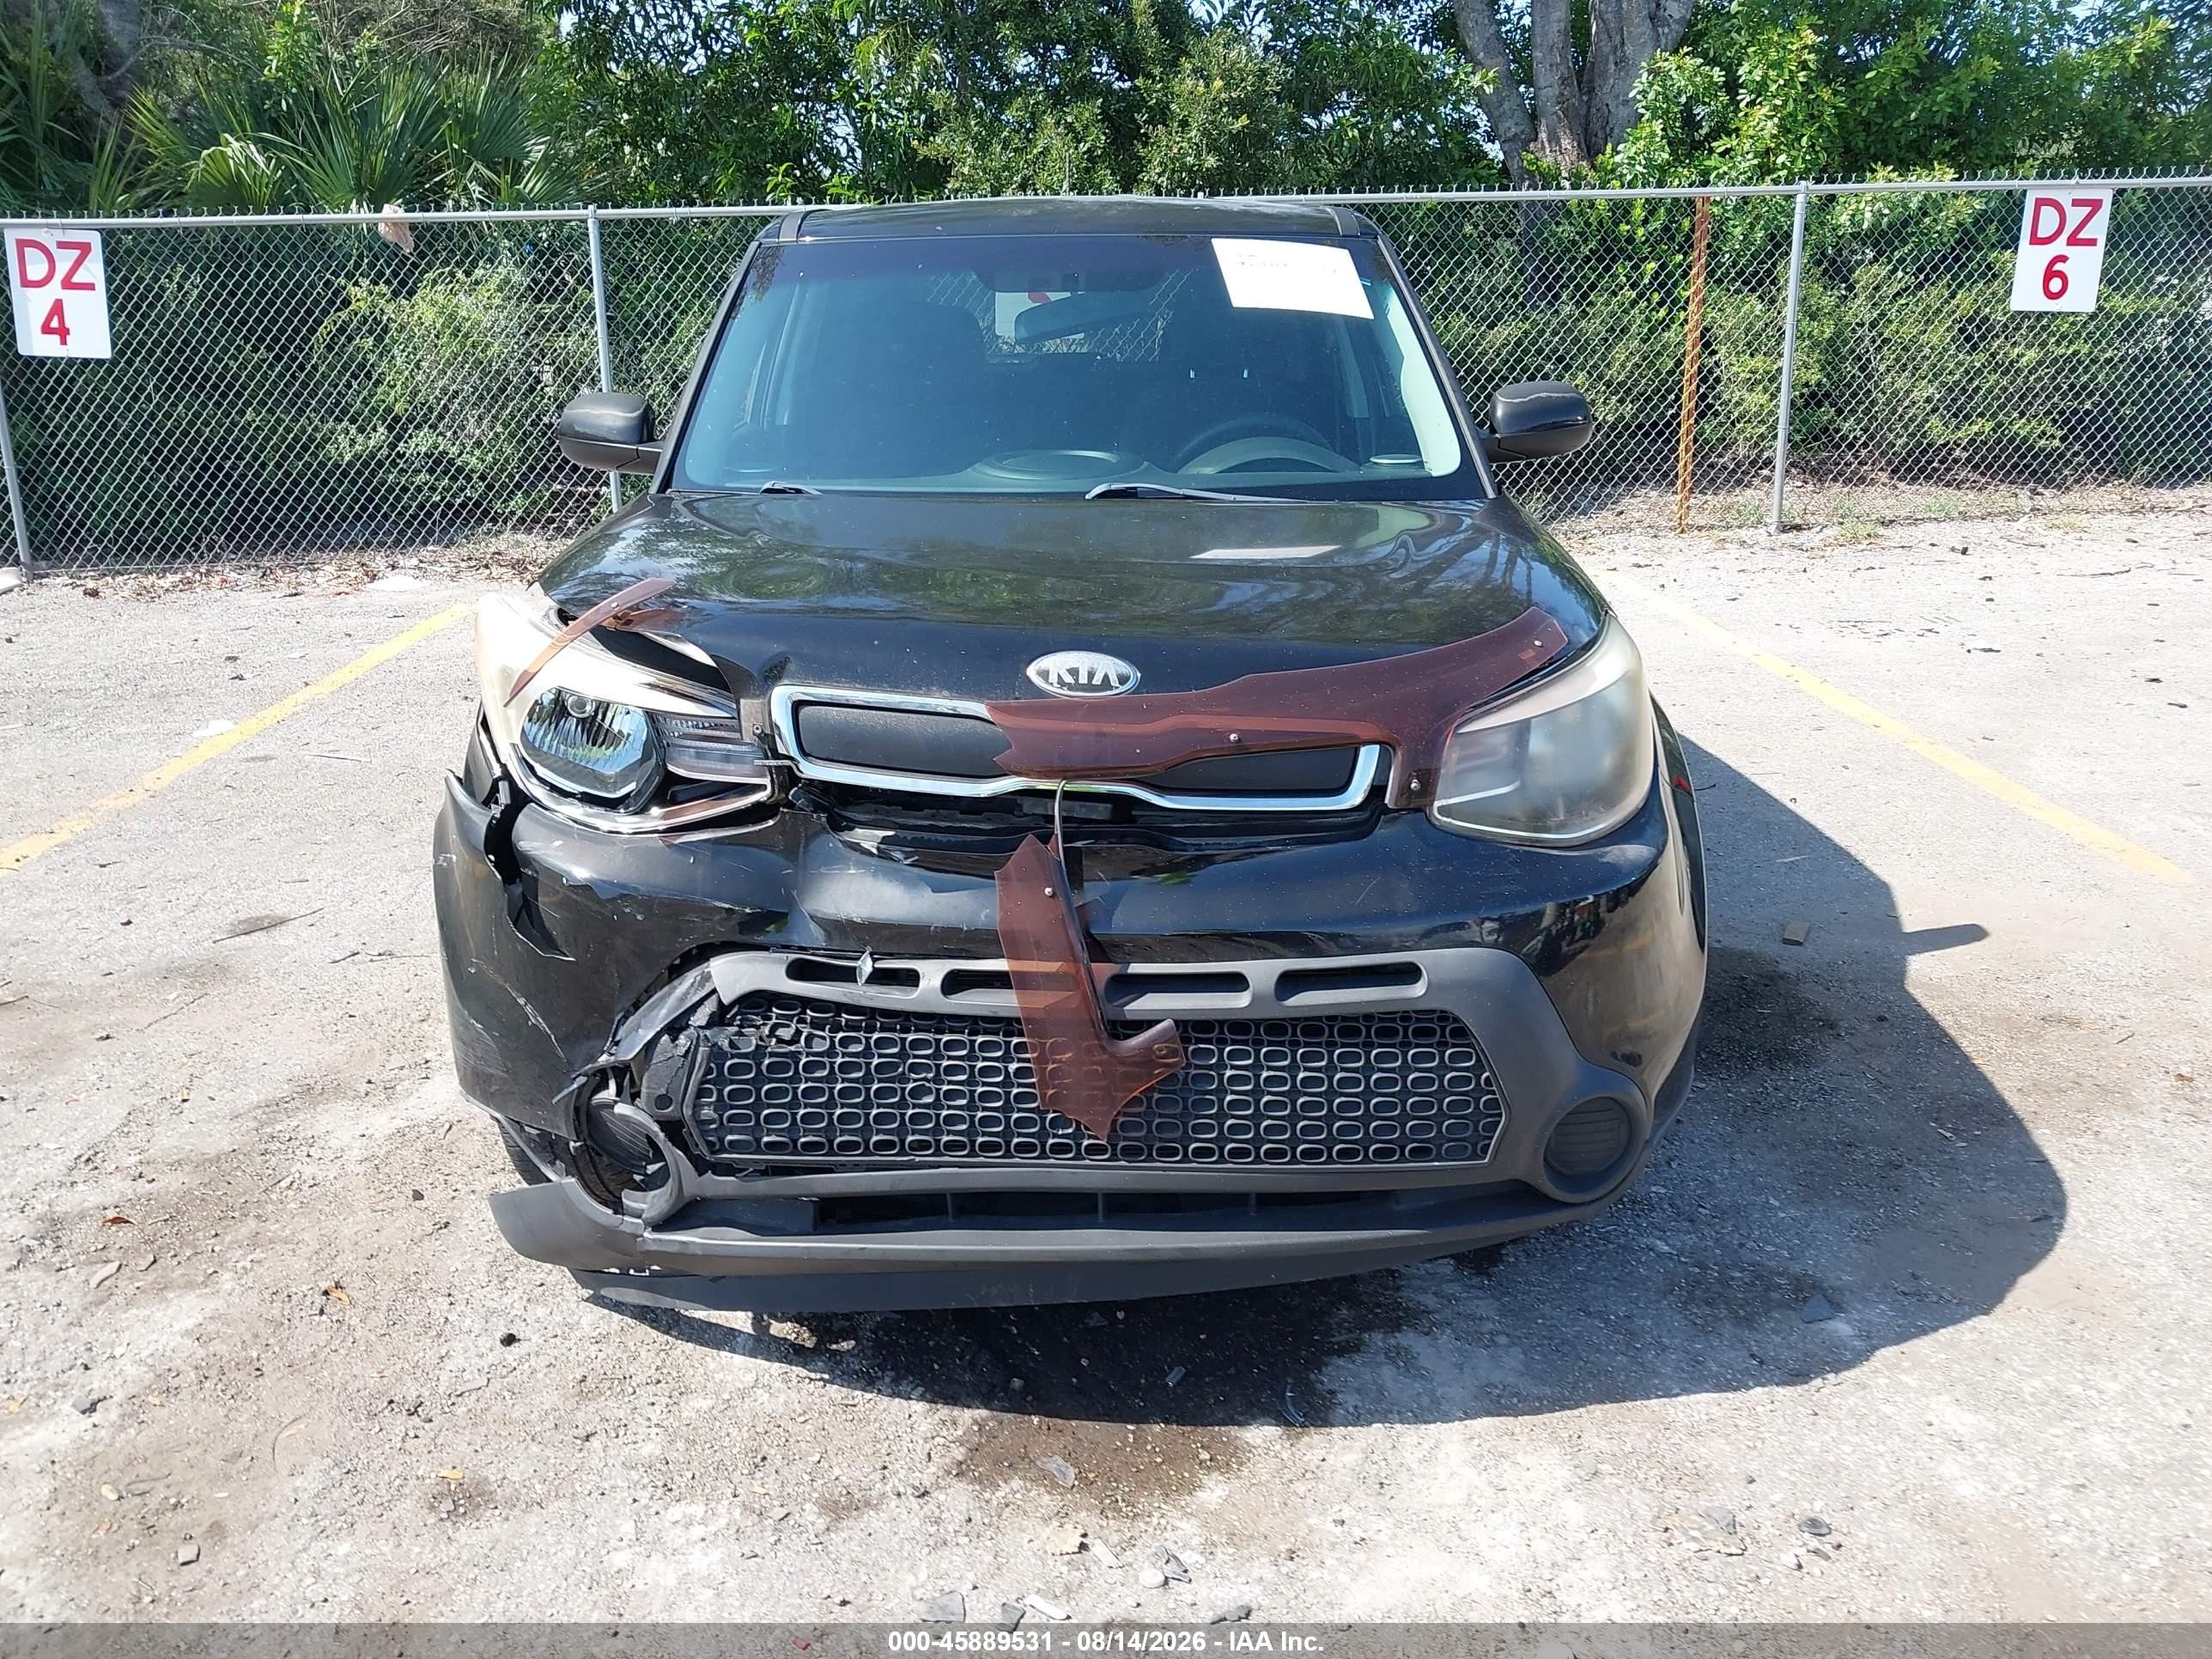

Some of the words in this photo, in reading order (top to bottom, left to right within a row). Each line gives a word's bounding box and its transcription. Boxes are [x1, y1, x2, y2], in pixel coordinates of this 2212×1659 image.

[2029, 197, 2104, 247] DZ
[15, 238, 96, 292] DZ
[2042, 253, 2070, 301] 6
[40, 298, 70, 346] 4
[1048, 658, 1121, 688] KIA
